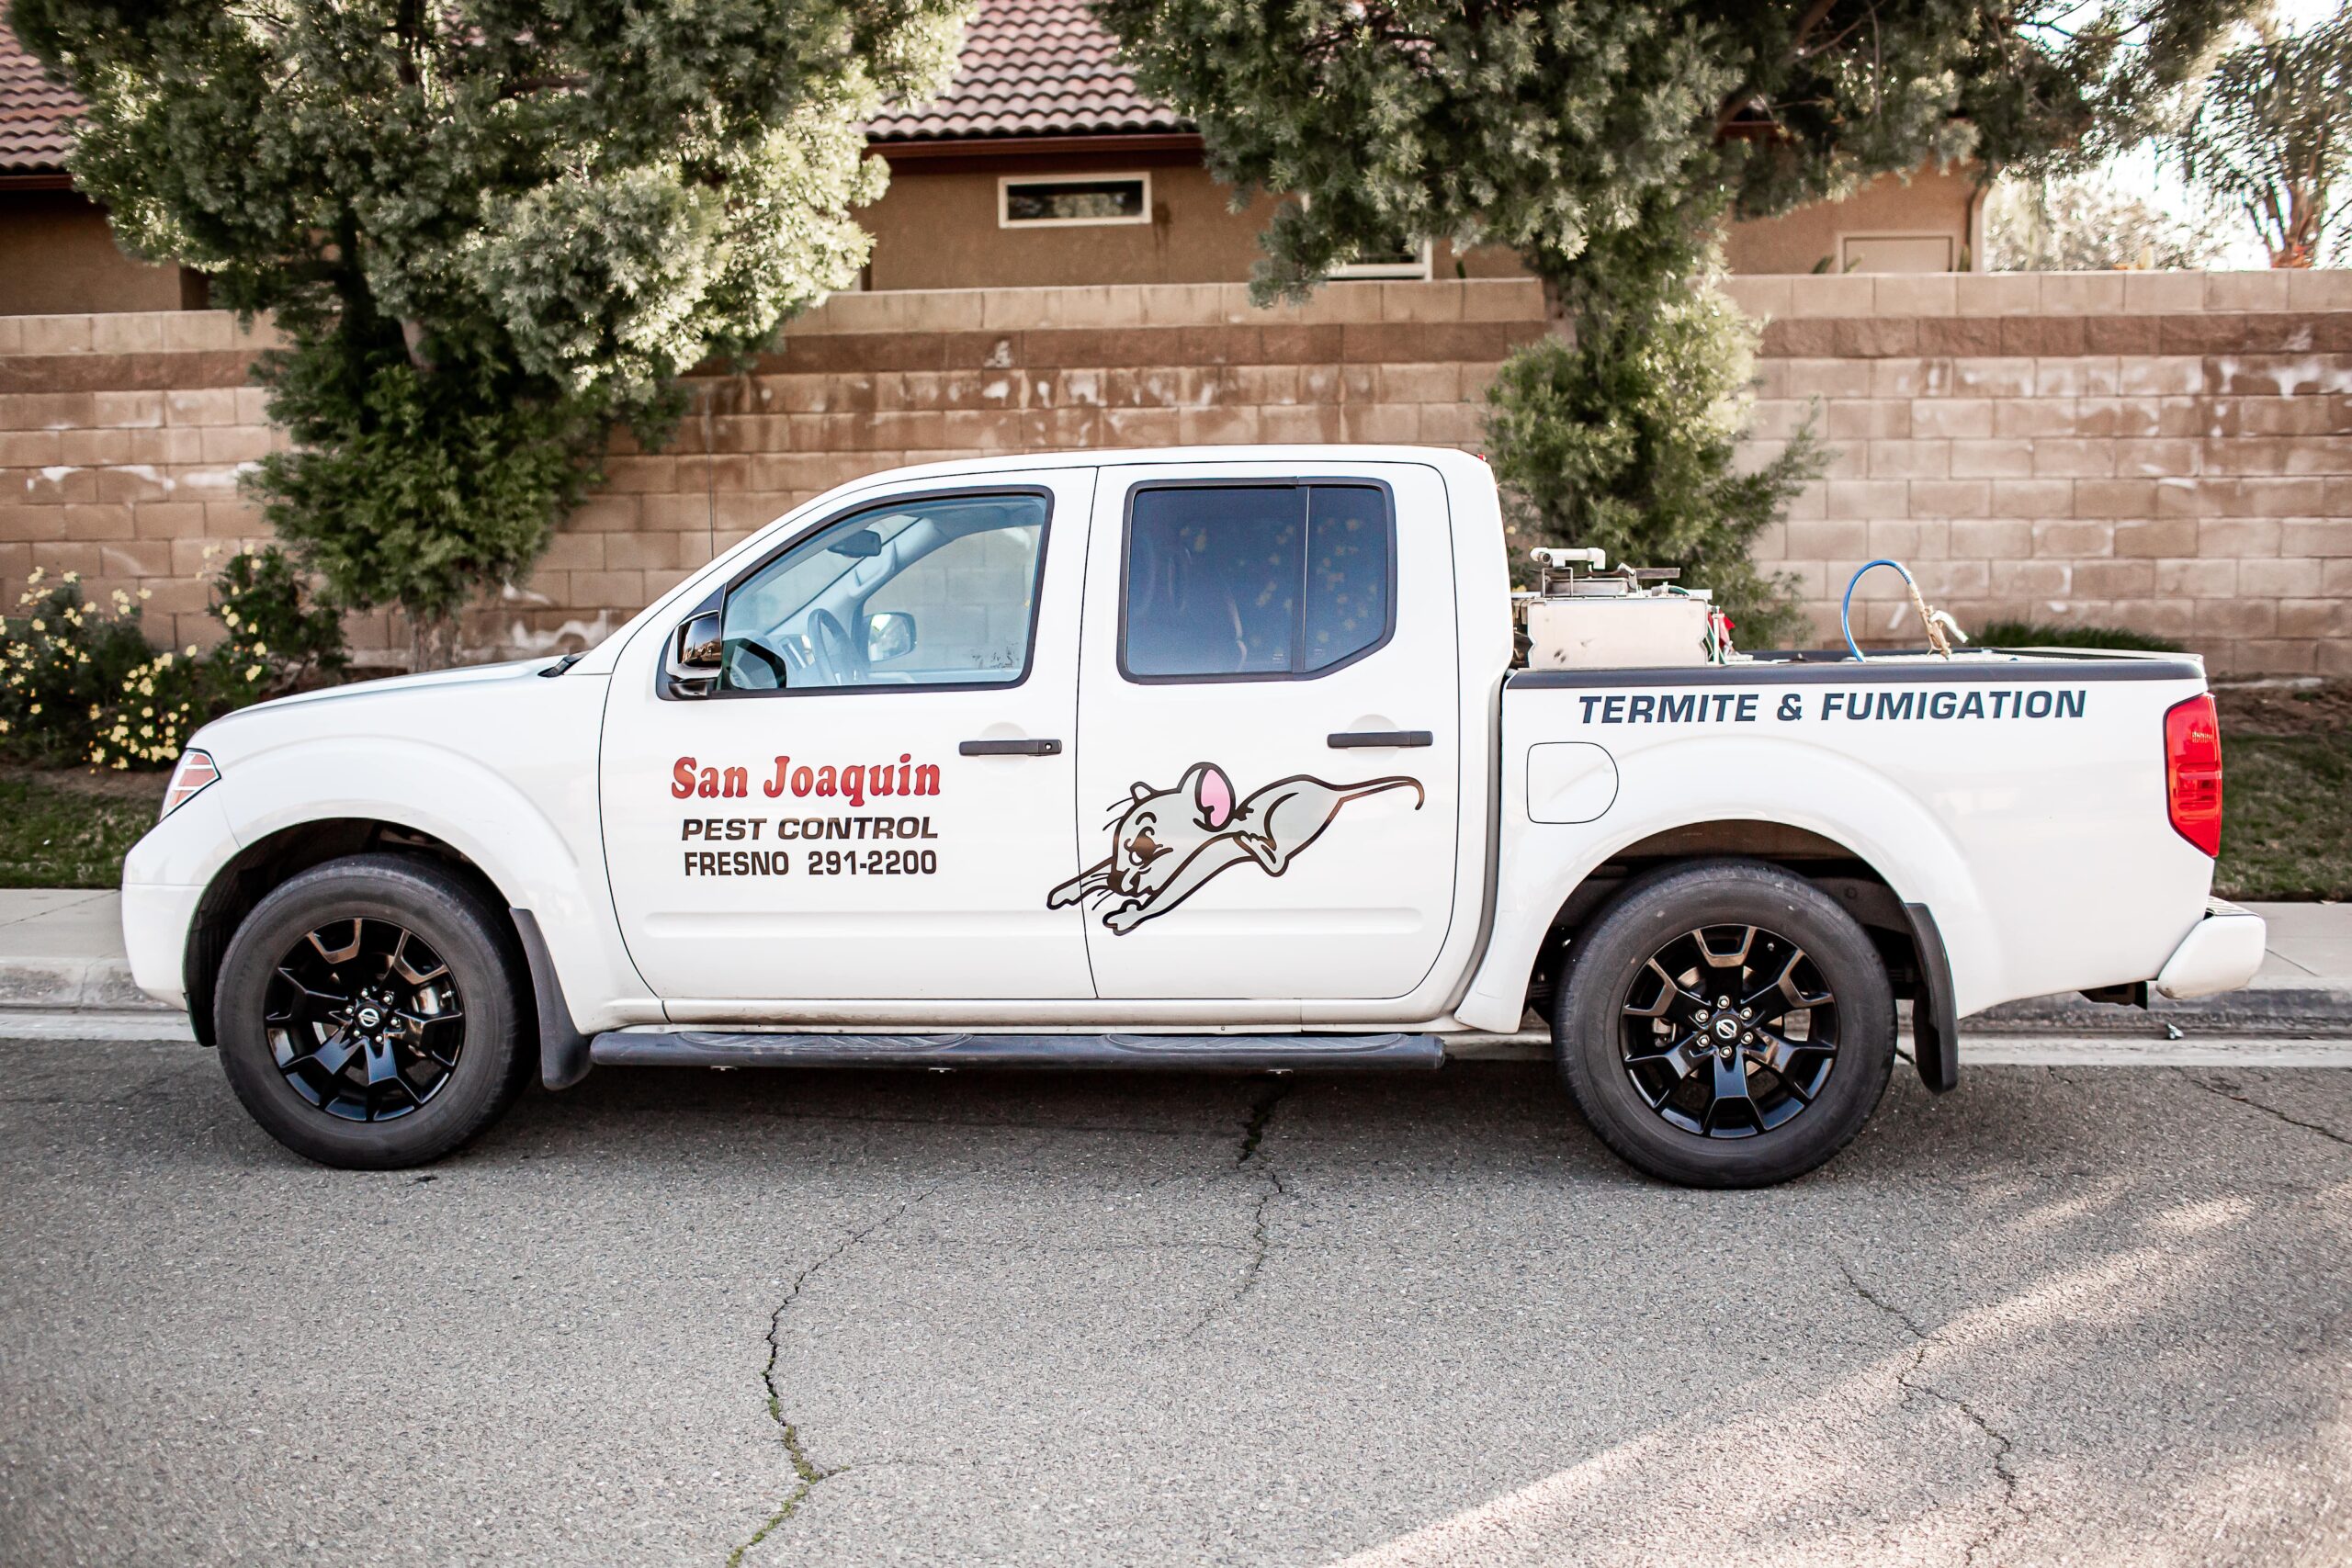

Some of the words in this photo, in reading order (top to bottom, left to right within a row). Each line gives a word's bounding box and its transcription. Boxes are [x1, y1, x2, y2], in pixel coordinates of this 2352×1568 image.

[1579, 694, 1758, 724] TERMITE
[1777, 694, 1802, 721] &
[1821, 690, 2086, 721] FUMIGATION
[672, 757, 748, 799] San
[763, 753, 940, 807] Joaquin
[682, 818, 767, 840] PEST
[778, 817, 938, 840] CONTROL
[684, 852, 788, 875] FRESNO
[808, 850, 936, 874] 291-2200
